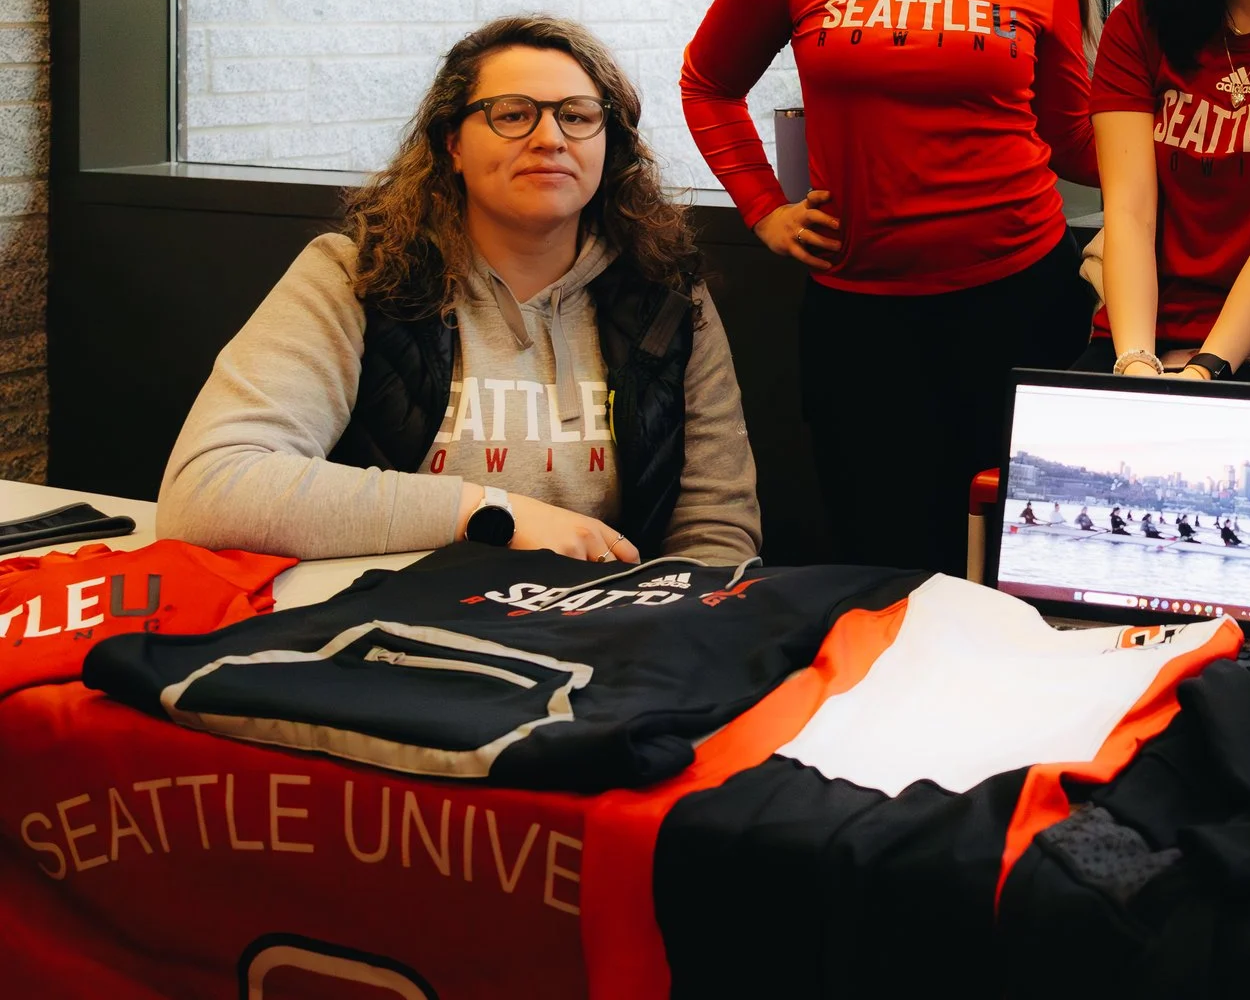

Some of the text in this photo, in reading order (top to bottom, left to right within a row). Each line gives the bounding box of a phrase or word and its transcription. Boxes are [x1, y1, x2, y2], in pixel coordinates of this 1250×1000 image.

[816, 29, 1018, 59] ROWING
[433, 376, 613, 443] EATTLE
[430, 447, 606, 474] OWIN
[20, 773, 583, 916] SEATTLE UNIVE
